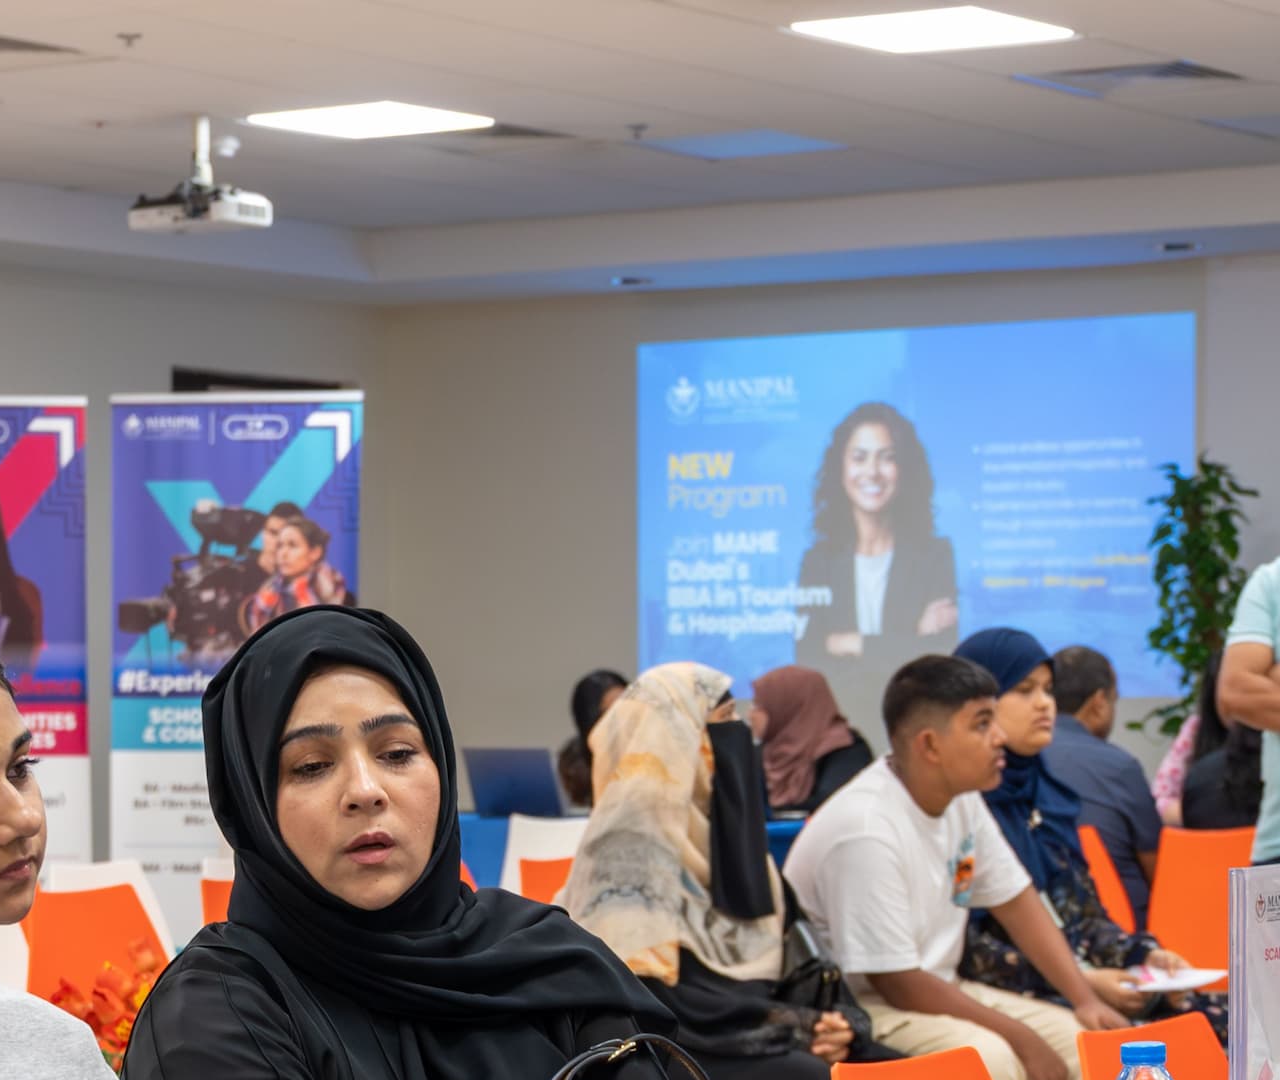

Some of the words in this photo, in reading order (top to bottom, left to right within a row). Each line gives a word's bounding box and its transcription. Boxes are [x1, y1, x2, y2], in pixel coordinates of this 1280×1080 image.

[668, 450, 733, 480] NEW
[668, 483, 787, 518] Program
[713, 530, 779, 555] MAHE
[668, 556, 750, 582] Dubai's
[668, 586, 712, 608] BBA
[714, 582, 737, 607] in
[738, 581, 833, 607] Tourism
[687, 610, 811, 641] Hospitality
